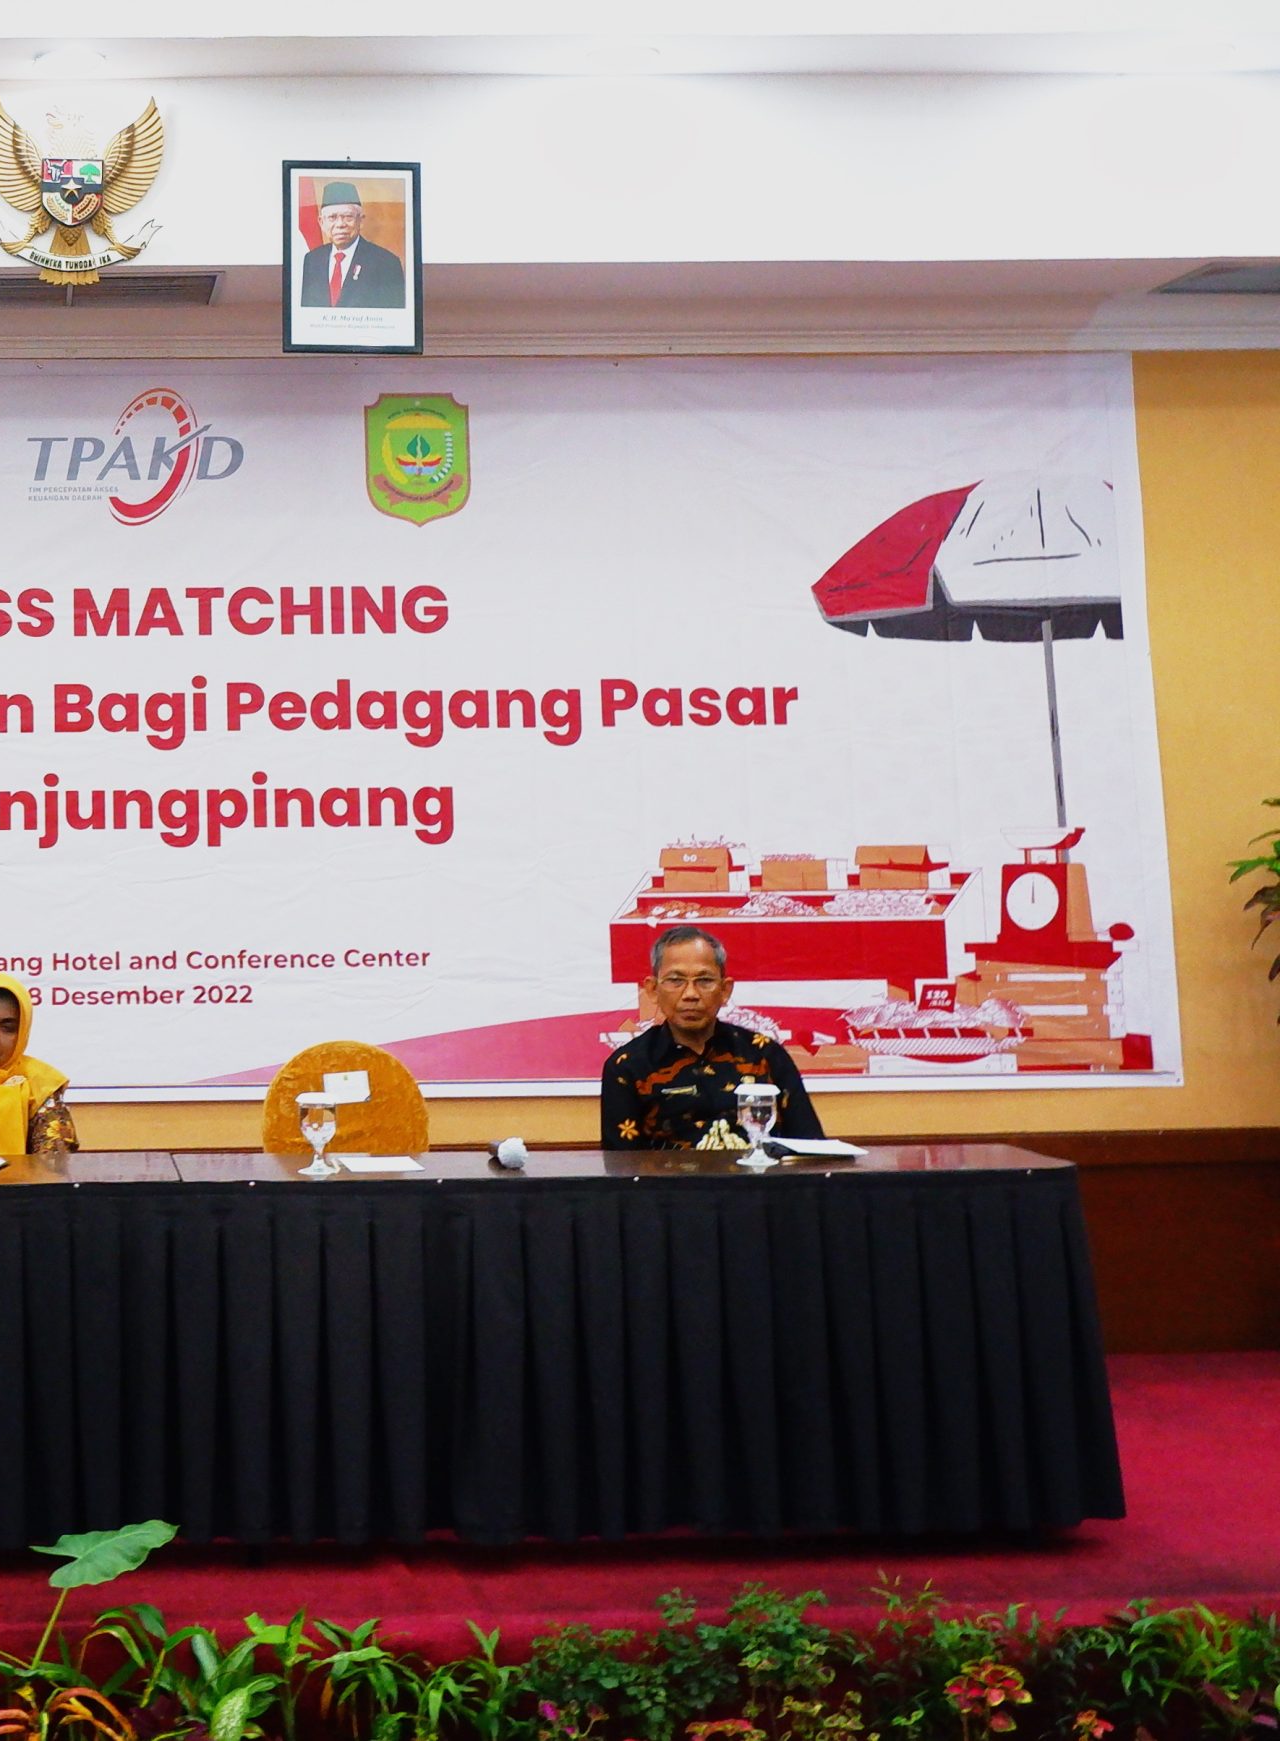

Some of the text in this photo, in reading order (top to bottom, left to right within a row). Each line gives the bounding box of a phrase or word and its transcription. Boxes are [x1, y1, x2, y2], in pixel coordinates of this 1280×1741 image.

[99, 254, 112, 265] IKA
[28, 486, 42, 494] TIM
[73, 585, 449, 637] MATCHING
[53, 675, 208, 751] Bagi
[225, 678, 582, 749] Pedagang
[599, 678, 799, 728] Pasar
[51, 952, 121, 971] Hotel
[129, 951, 177, 970] and
[186, 949, 335, 970] Conference
[343, 948, 430, 968] Center
[51, 986, 184, 1007] Desember
[193, 984, 253, 1005] 2022
